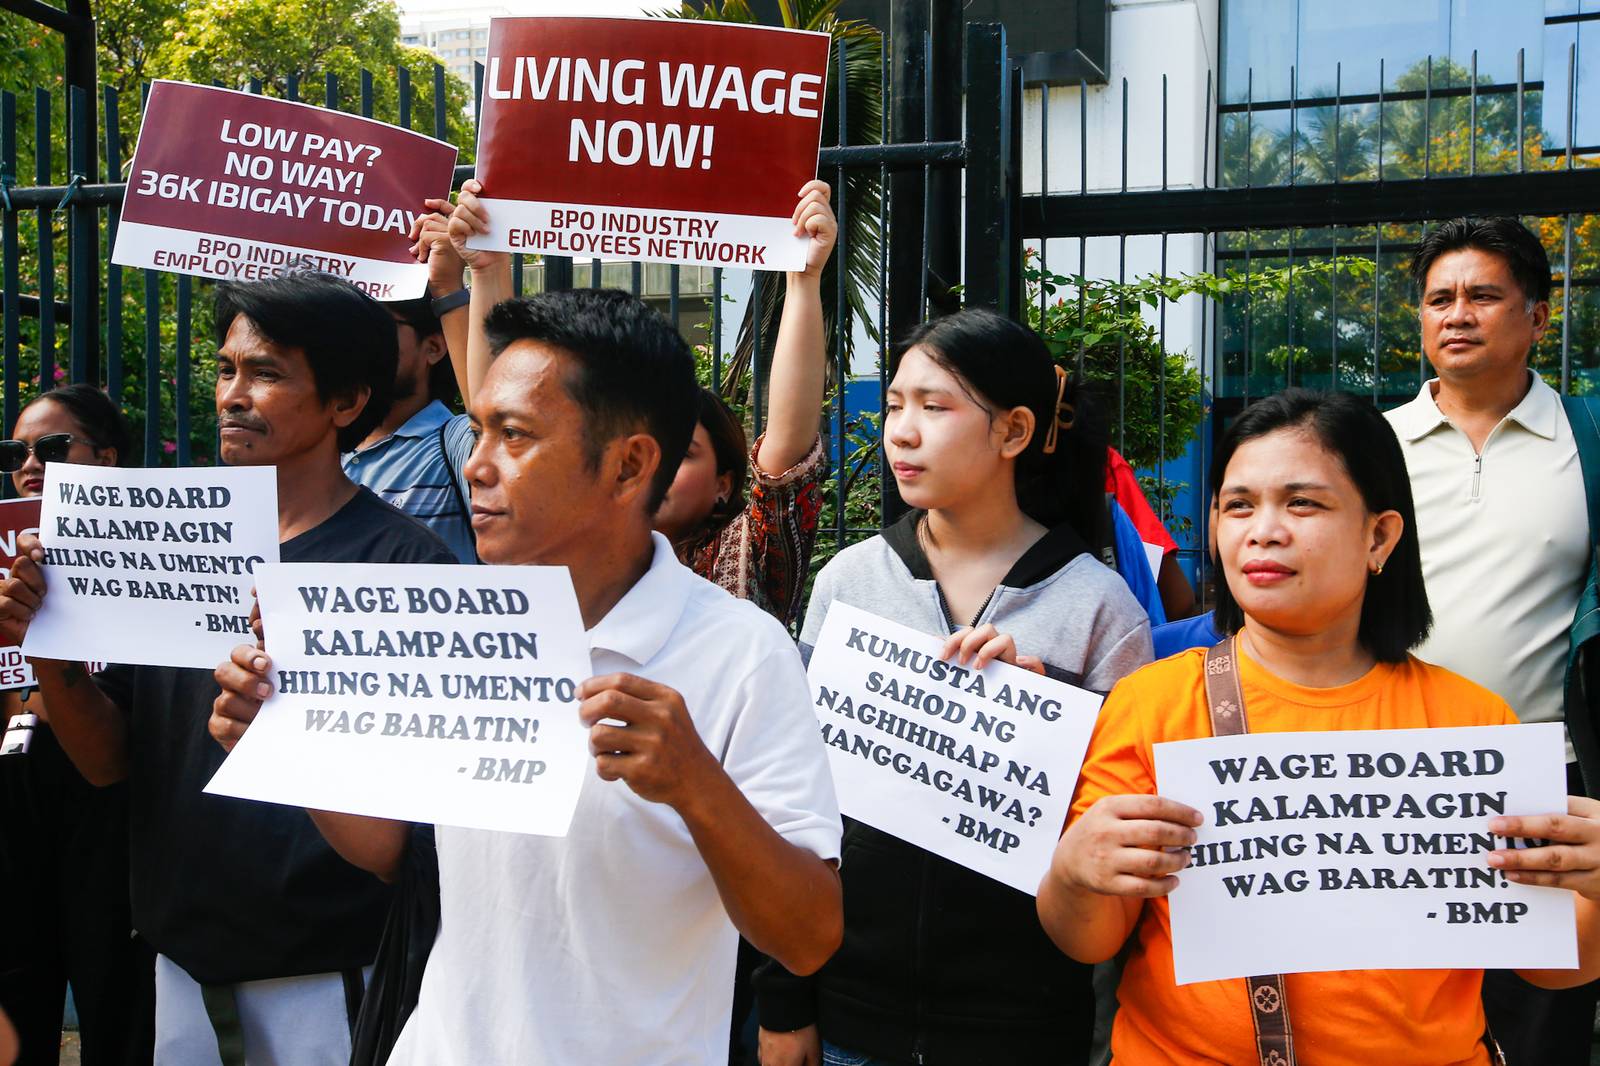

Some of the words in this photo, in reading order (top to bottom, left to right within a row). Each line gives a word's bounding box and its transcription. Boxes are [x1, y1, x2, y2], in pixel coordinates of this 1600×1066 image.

[488, 56, 645, 106] LIVING
[658, 61, 823, 119] WAGE
[219, 119, 298, 152] LOW
[302, 134, 382, 167] PAY?
[568, 118, 715, 171] NOW!
[224, 151, 274, 181] NO
[281, 159, 365, 195] WAY!
[136, 170, 204, 203] 36K
[207, 181, 315, 219] IBIGAY
[550, 209, 595, 231] BPO
[602, 212, 720, 239] INDUSTRY
[197, 237, 242, 260] BPO
[508, 228, 641, 256] EMPLOYEES
[647, 238, 767, 265] NETWORK
[59, 482, 124, 508] WAGE
[126, 486, 231, 509] BOARD
[56, 516, 233, 544] KALAMPAGIN
[42, 547, 117, 569] HILING
[119, 551, 157, 571] NA
[67, 576, 123, 598] WAG
[128, 580, 240, 605] BARATIN!
[298, 586, 400, 614] WAGE
[405, 587, 529, 615] BOARD
[303, 629, 538, 660] KALAMPAGIN
[278, 670, 381, 696] HILING
[388, 672, 433, 698] NA
[440, 673, 577, 703] UMENTO
[846, 627, 987, 698] KUMUSTA
[993, 684, 1062, 722] ANG
[865, 671, 966, 724] SAHOD
[970, 710, 1016, 743] NG
[304, 709, 376, 735] WAG
[381, 713, 540, 743] BARATIN!
[815, 686, 1000, 773] NAGHIHIRAP
[1004, 760, 1051, 796] NA
[472, 757, 547, 784] BMP
[1209, 752, 1337, 785] WAGE
[1347, 749, 1505, 779] BOARD
[1213, 791, 1507, 827] KALAMPAGIN
[955, 813, 1021, 854] BMP
[1183, 834, 1307, 868] HILING
[1316, 832, 1372, 857] NA
[1383, 831, 1550, 856] UMEN
[1222, 869, 1310, 898] WAG
[1446, 901, 1529, 925] BMP
